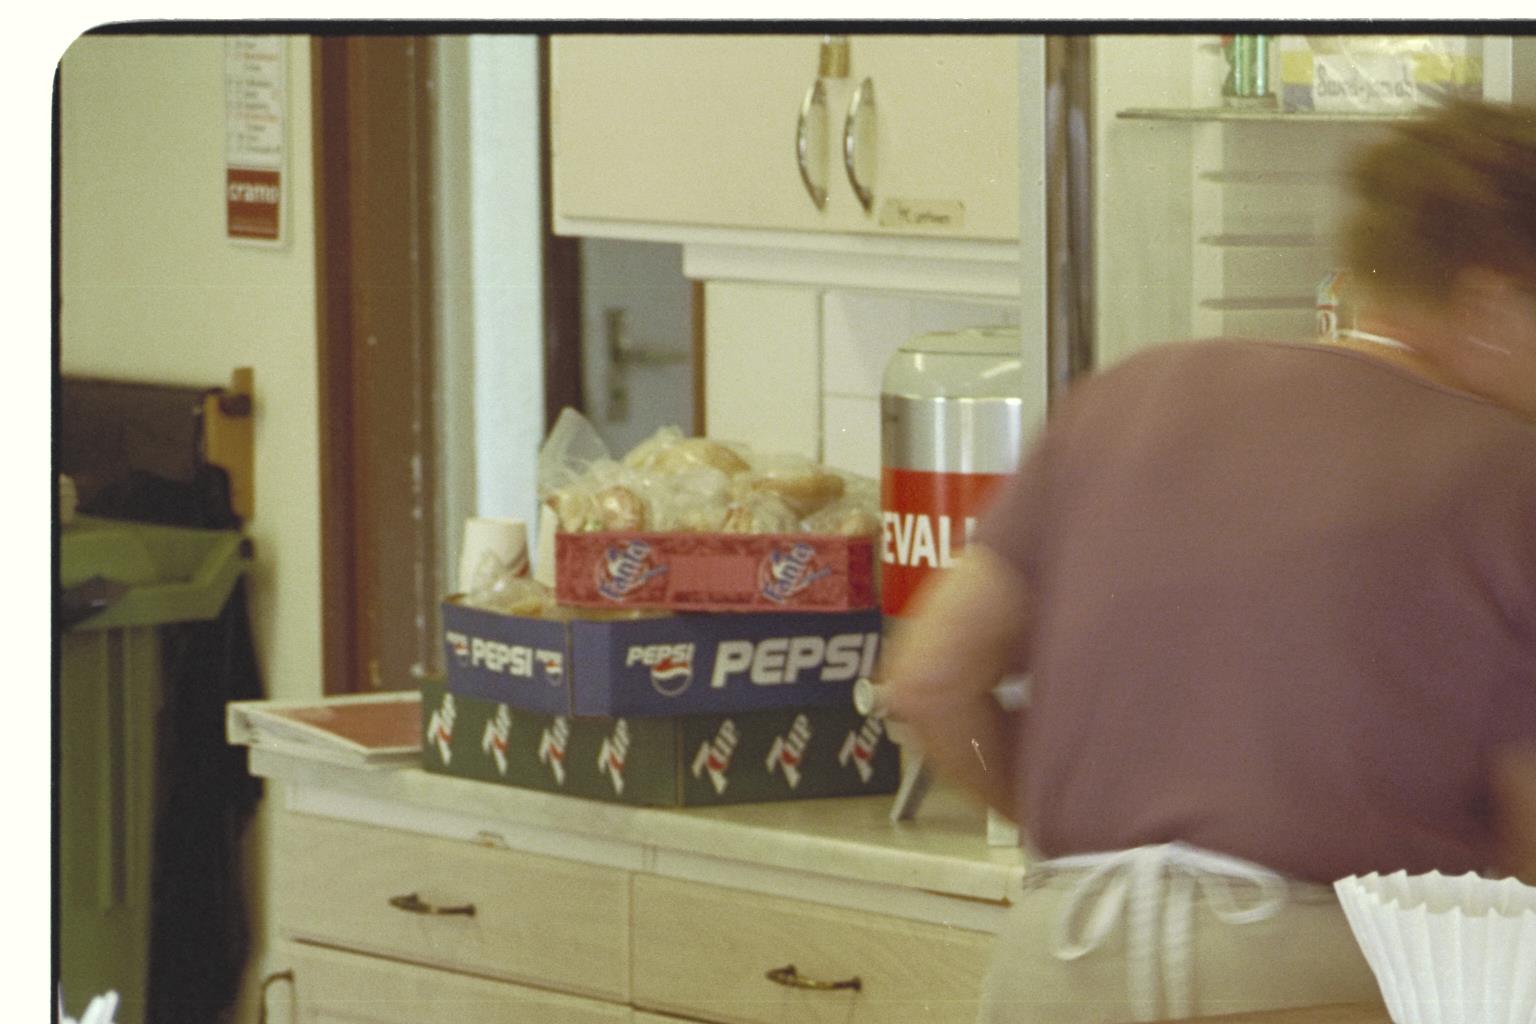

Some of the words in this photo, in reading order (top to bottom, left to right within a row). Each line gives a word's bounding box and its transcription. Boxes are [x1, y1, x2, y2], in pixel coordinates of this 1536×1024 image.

[597, 539, 651, 601] Fanta
[762, 543, 816, 603] Fanta
[471, 637, 535, 678] PEPSI
[626, 642, 695, 668] PEPSI
[710, 632, 879, 689] PEPSI
